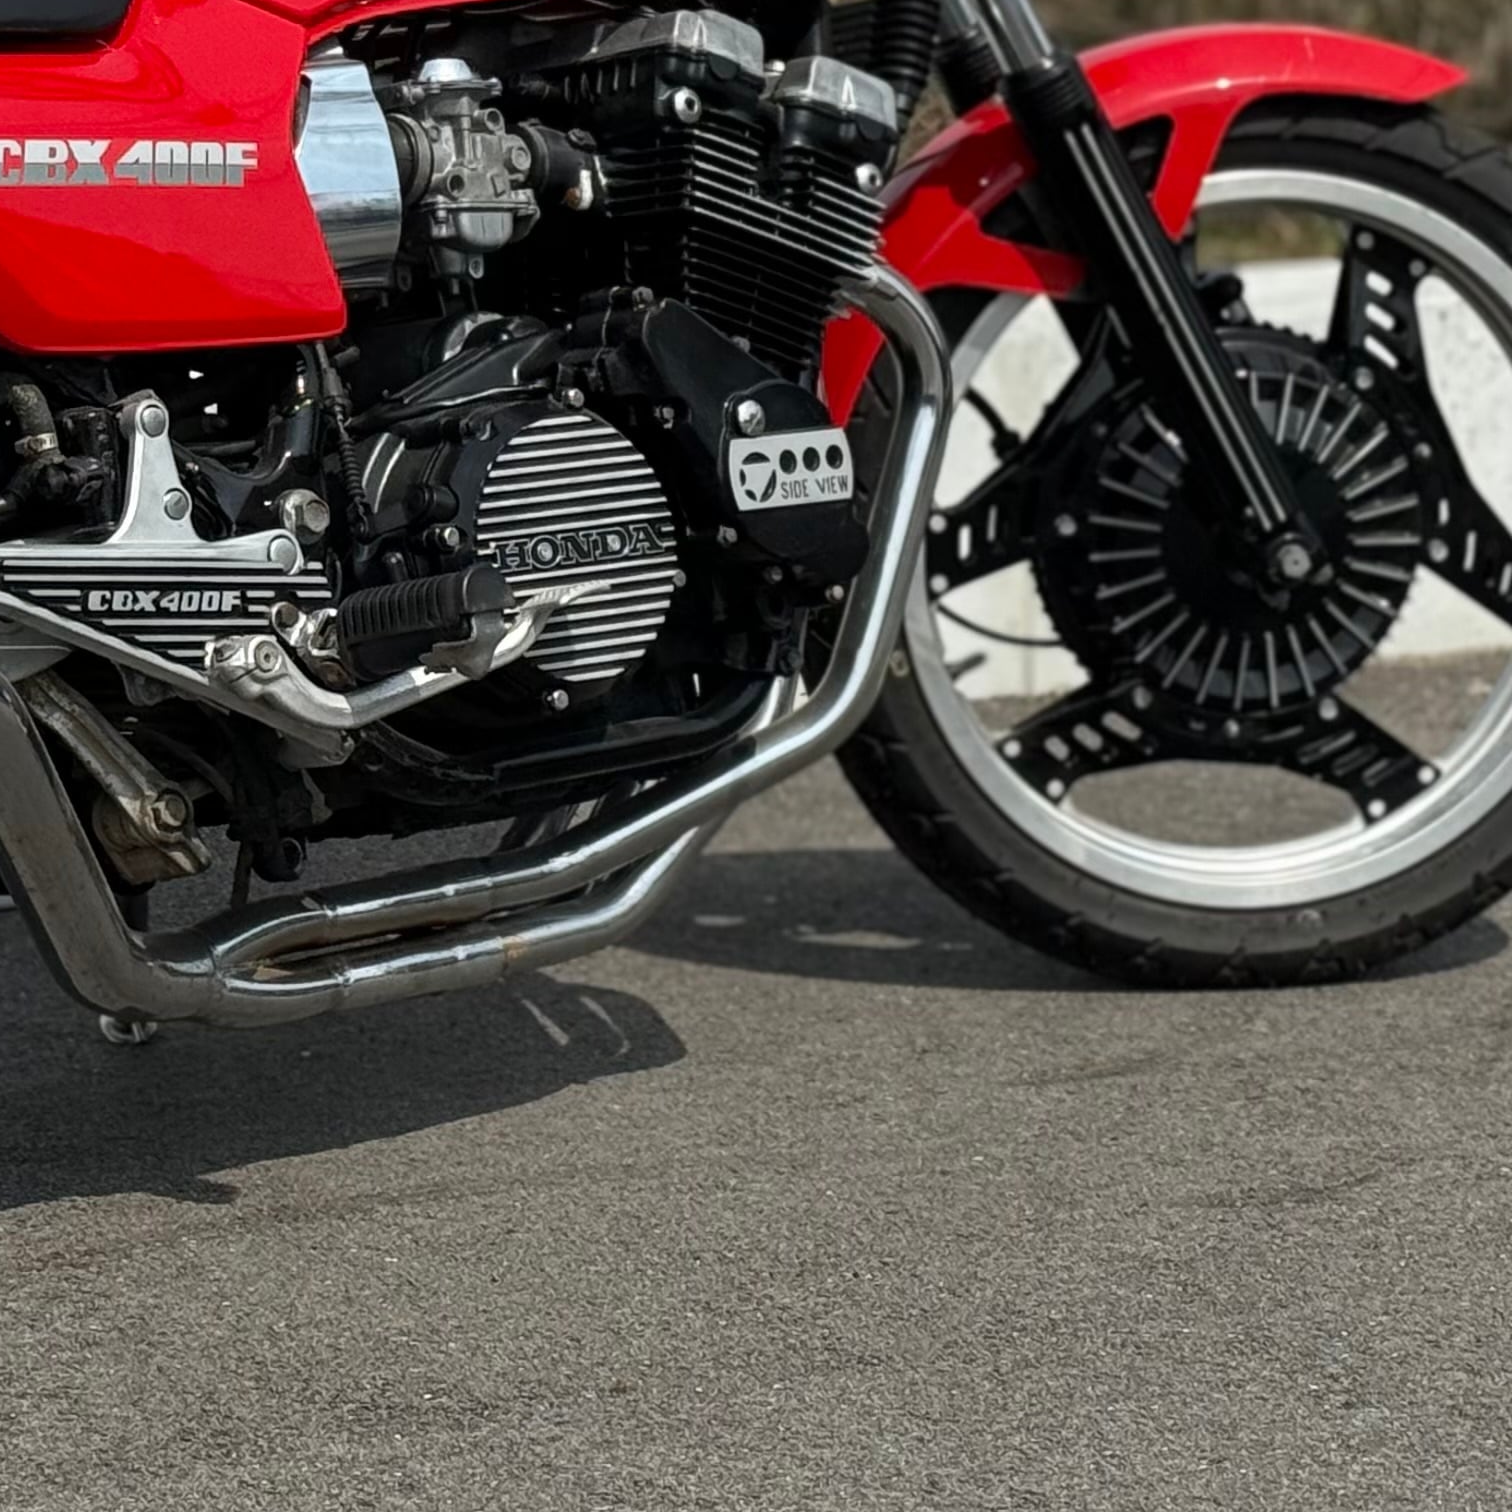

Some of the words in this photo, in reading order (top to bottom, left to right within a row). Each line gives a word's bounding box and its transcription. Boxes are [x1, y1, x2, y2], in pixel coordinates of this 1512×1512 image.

[780, 479, 809, 500] SIDE
[815, 474, 848, 495] VIEW
[497, 523, 665, 573] HONDA
